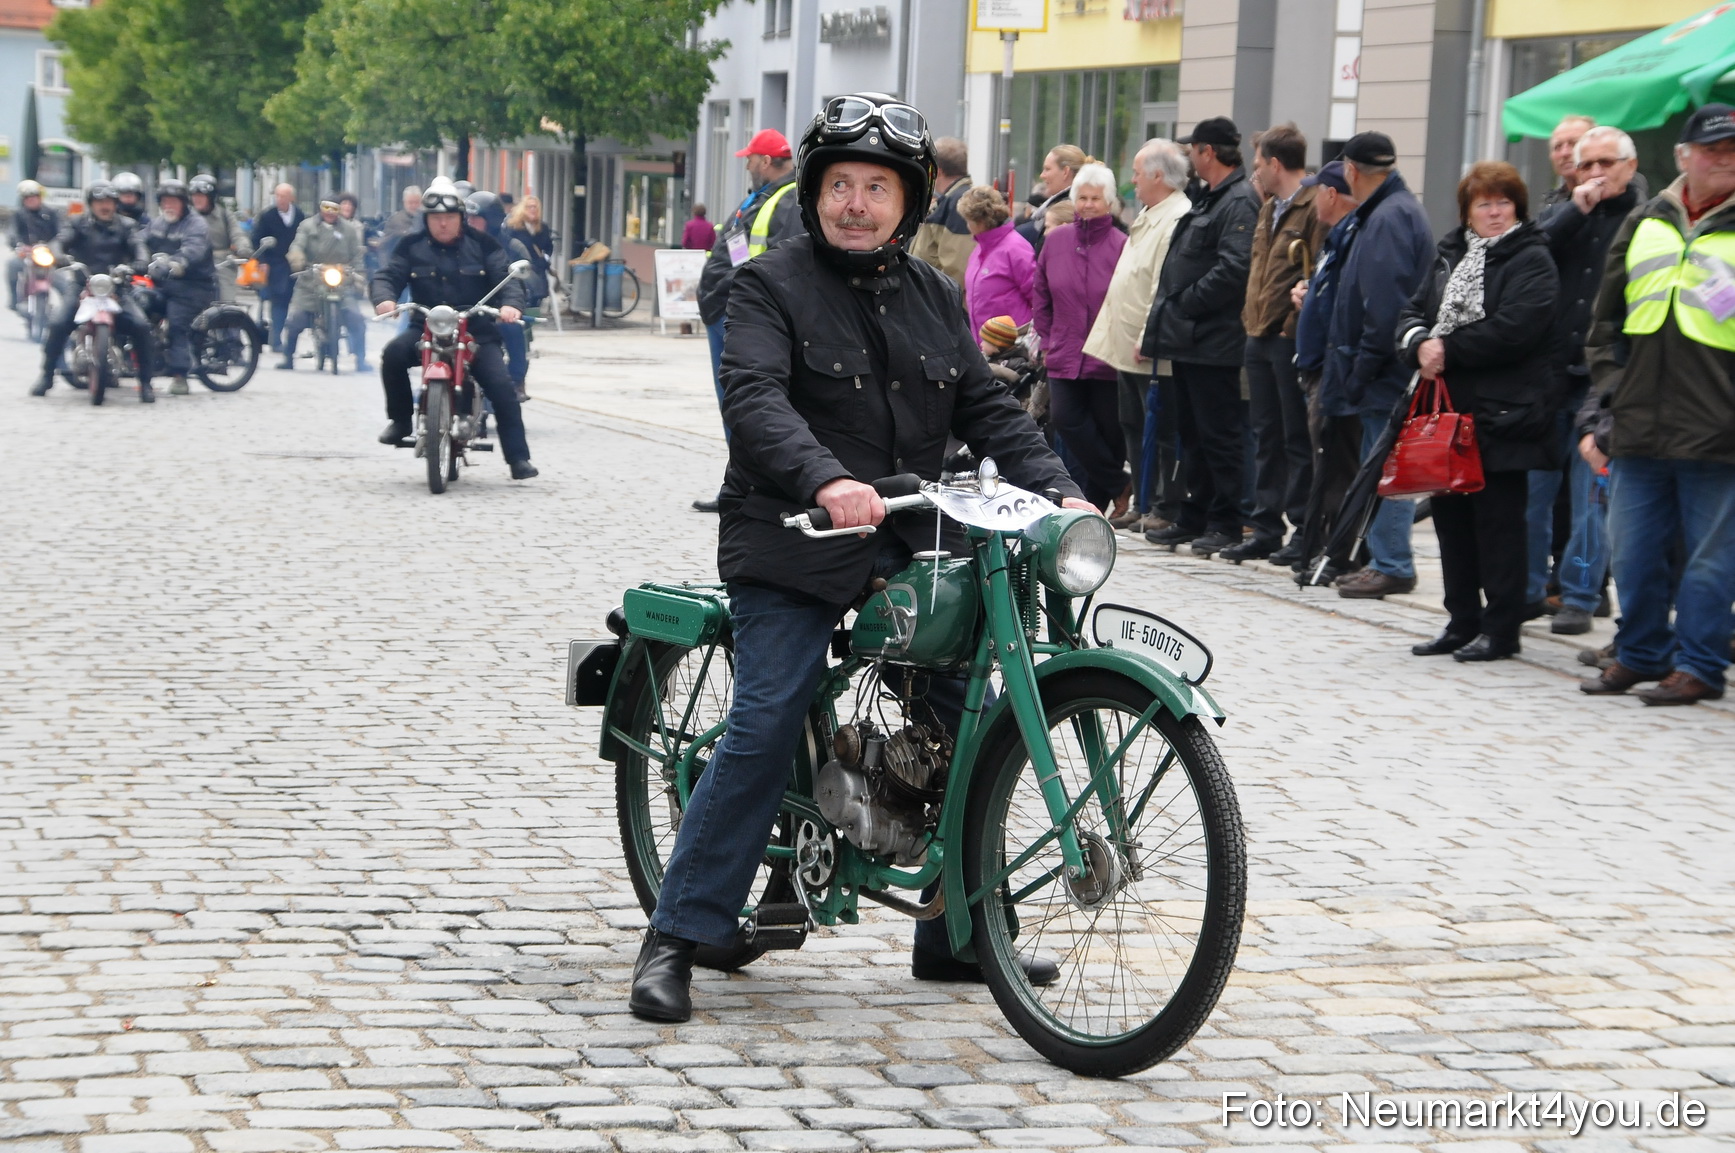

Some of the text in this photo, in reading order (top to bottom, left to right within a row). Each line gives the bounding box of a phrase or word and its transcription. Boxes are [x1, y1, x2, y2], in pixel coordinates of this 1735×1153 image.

[645, 610, 680, 625] WANDERER
[859, 622, 888, 632] WANDERER
[1121, 620, 1185, 661] IIE-500175
